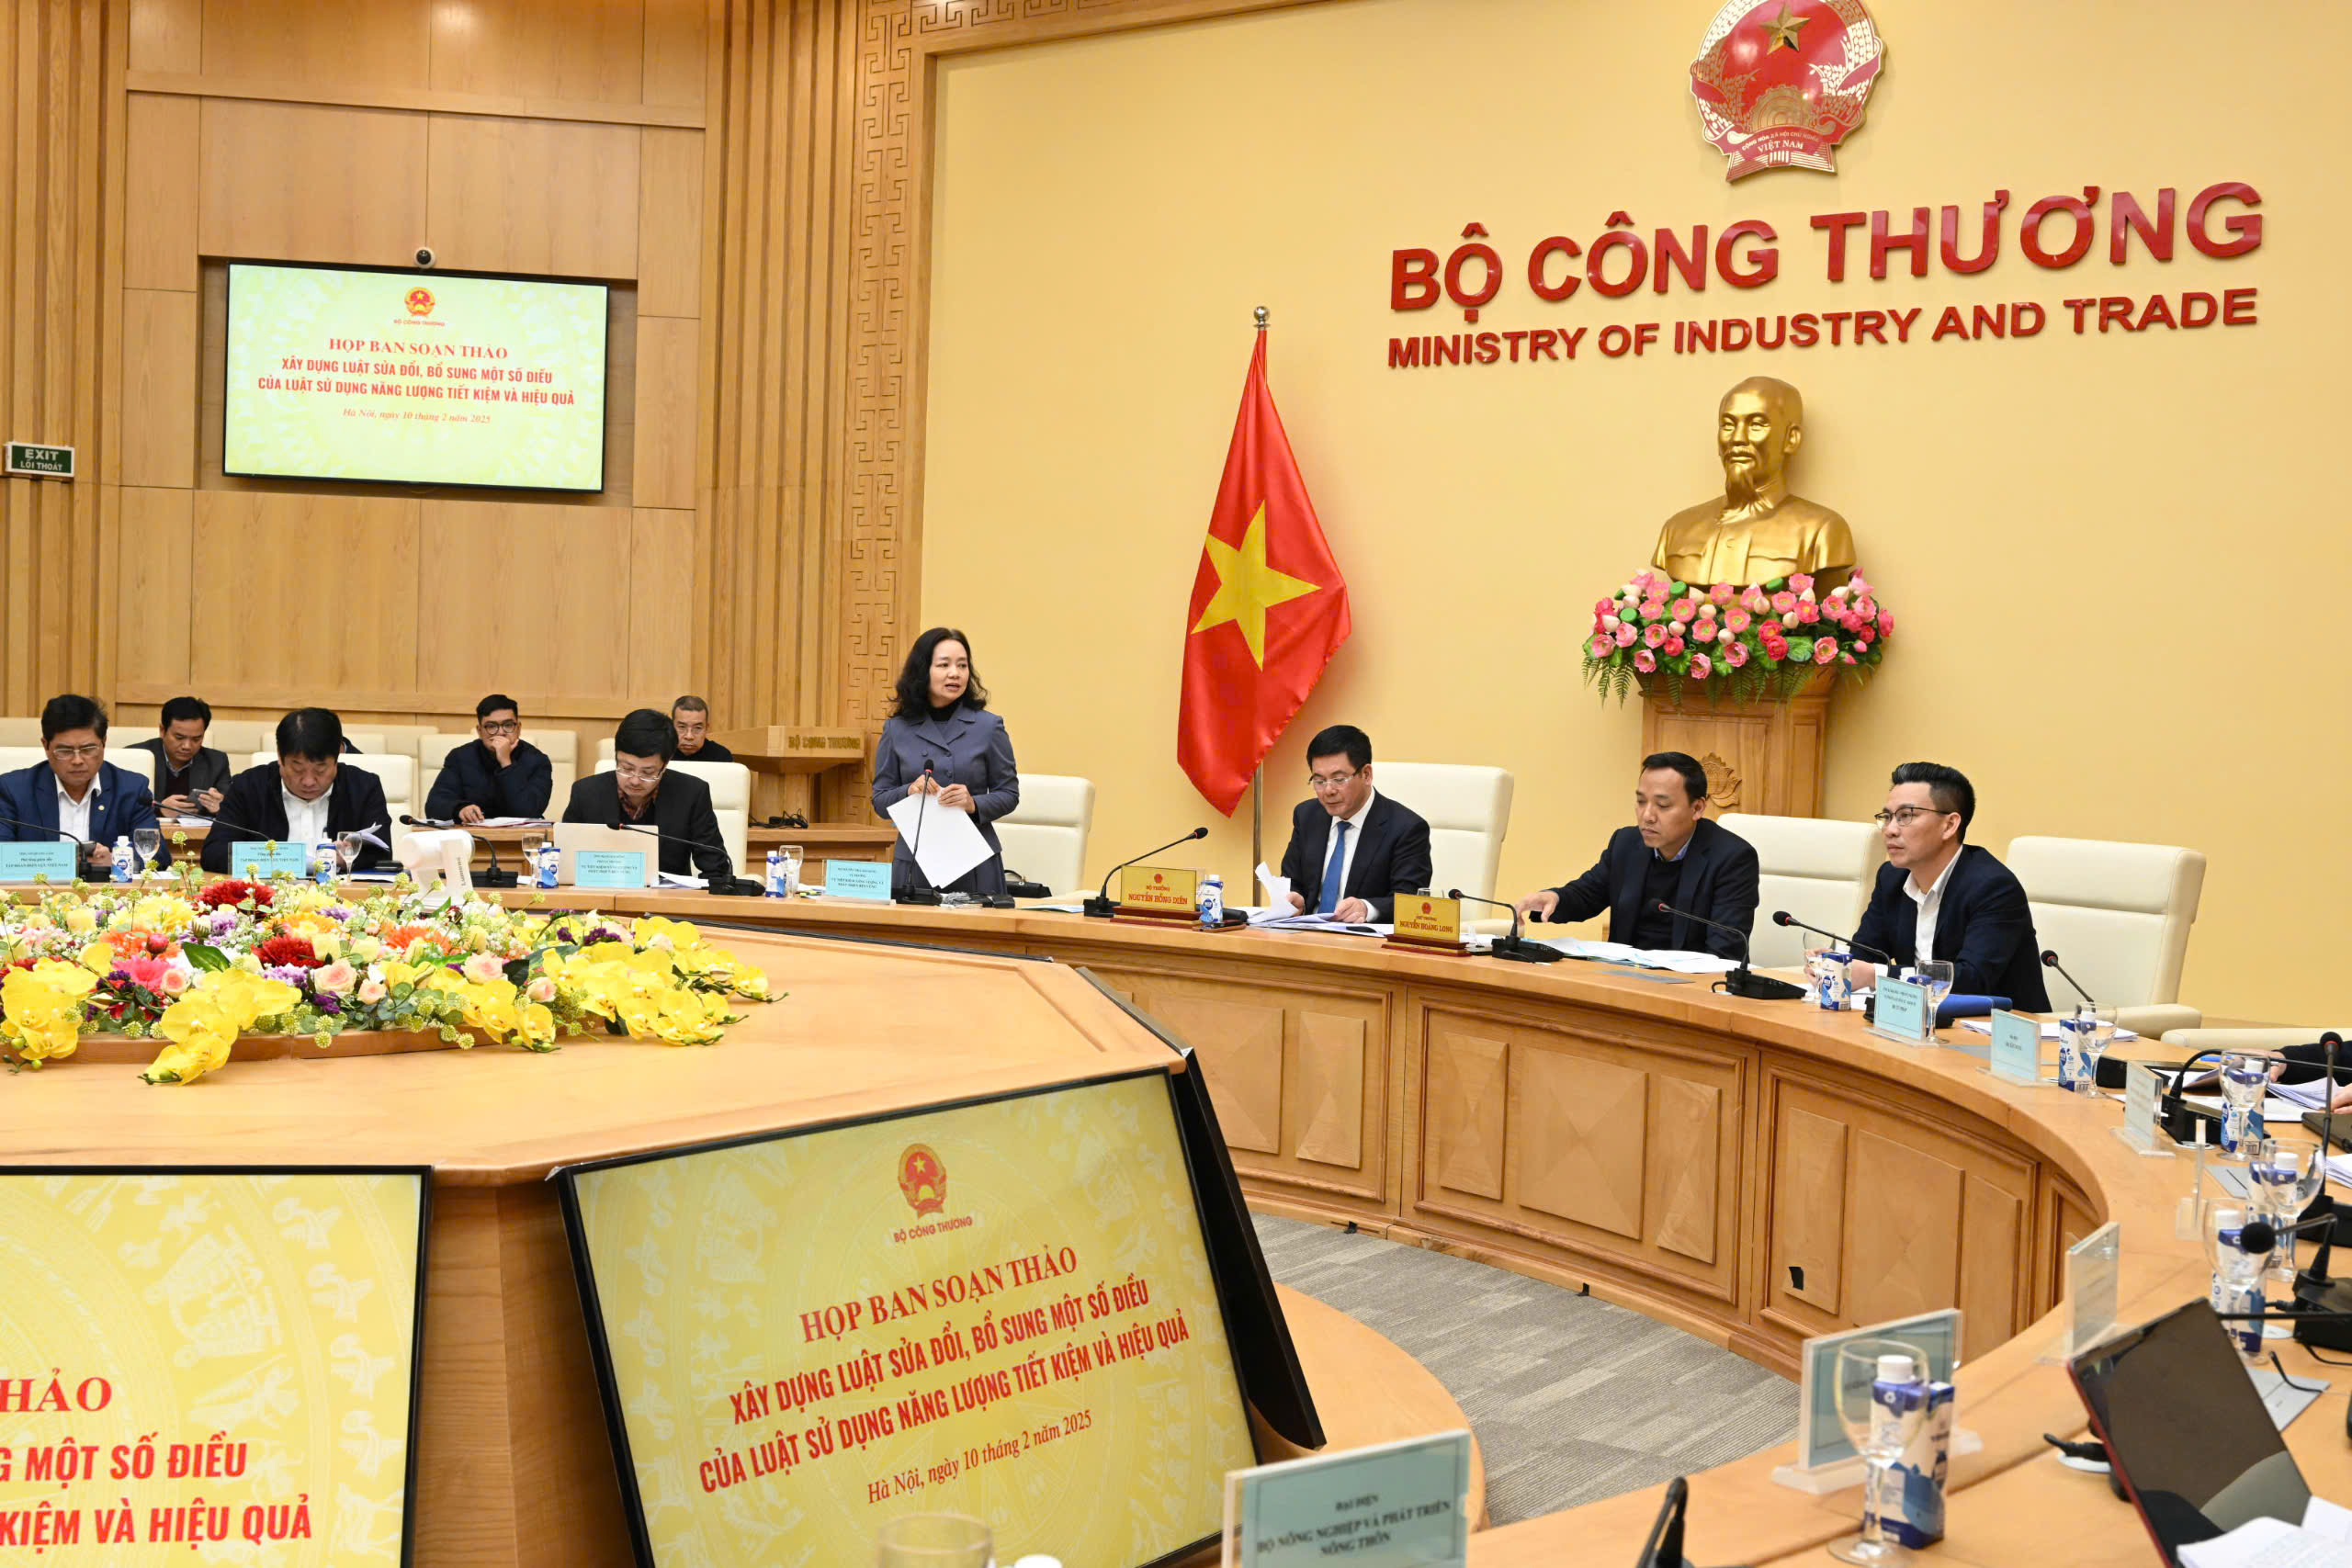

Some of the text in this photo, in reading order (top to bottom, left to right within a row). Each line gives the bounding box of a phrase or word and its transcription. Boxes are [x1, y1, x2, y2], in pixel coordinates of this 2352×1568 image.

[1758, 140, 1804, 152] VIỆT NAM
[1391, 181, 2263, 322] BỘ CÔNG THƯƠNG
[329, 337, 508, 359] HỌP BAN SOẠN THẢO
[1388, 288, 2258, 367] MINISTRY OF INDUSTRY AND TRADE
[20, 458, 63, 471] LỐI THOÁT
[25, 448, 59, 461] EXIT
[893, 1215, 973, 1244] BỘ CÔNG THƯƠNG
[798, 1244, 1078, 1343] HỌP BAN SOẠN THẢO
[729, 1272, 1149, 1425] XÂY DỰNG LUẬT SỬA ĐỔI, BỔ SUNG MỘT SỐ ĐIỀU
[698, 1307, 1191, 1494] CỦA LUẬT SỬ DỤNG NĂNG LƯỢNG TIẾT KIỆM VÀ HIỆU QUẢ
[24, 1436, 99, 1490] MỘT
[109, 1431, 159, 1480] SỐ
[166, 1430, 248, 1479] ĐIỀU
[867, 1408, 1092, 1504] Hà Nội, ngày 10 tháng 2 năm 2025
[0, 1493, 311, 1555] KIỆM VÀ HIỆU QUẢ
